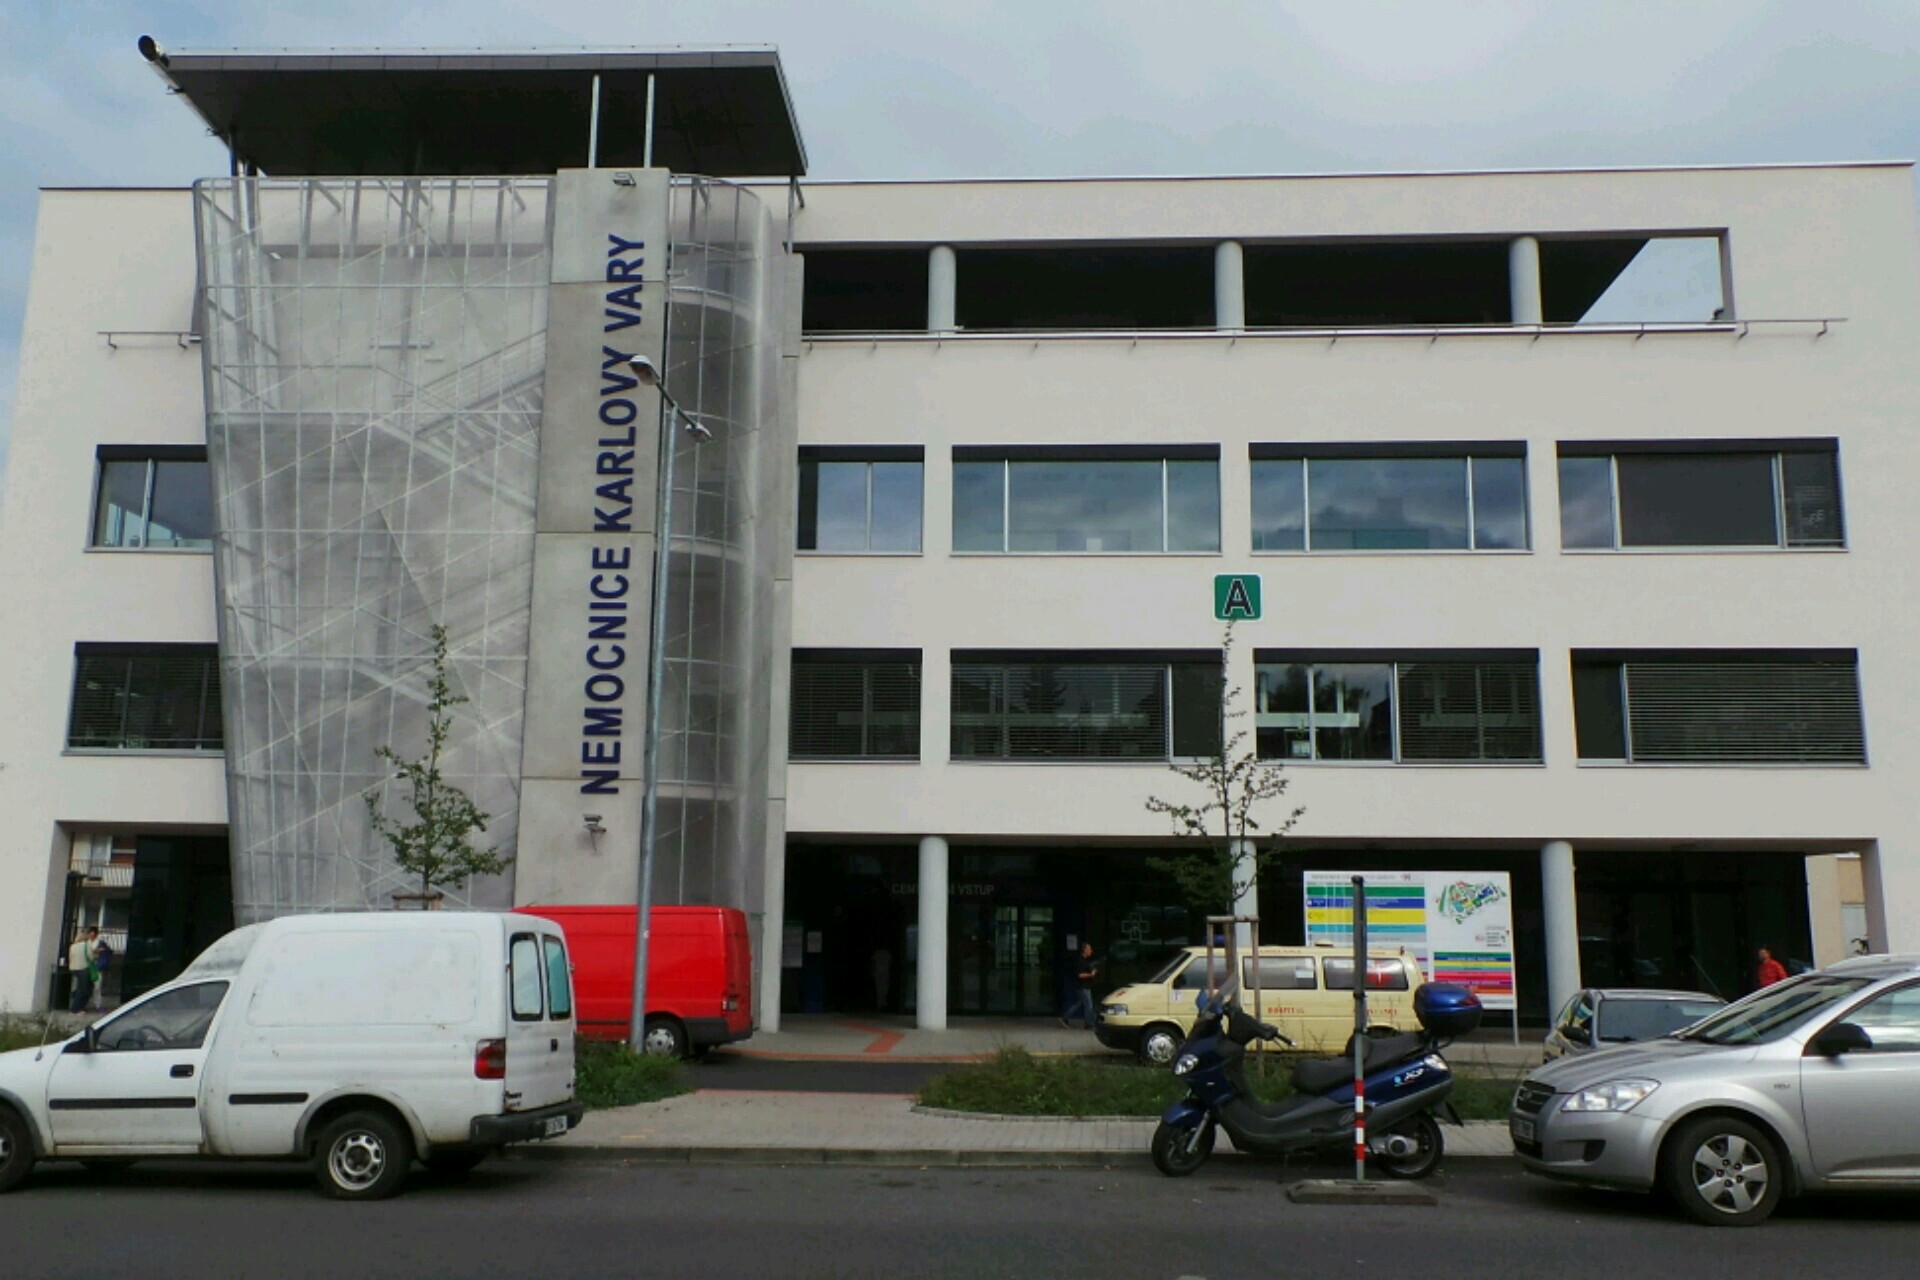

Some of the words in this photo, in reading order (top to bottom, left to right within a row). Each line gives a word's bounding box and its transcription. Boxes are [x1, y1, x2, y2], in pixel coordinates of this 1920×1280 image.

[604, 233, 645, 333] VARY
[593, 345, 638, 532] KARLOVY
[1222, 578, 1255, 617] A
[580, 546, 631, 795] NEMOCNICE
[958, 882, 995, 896] VSTUP
